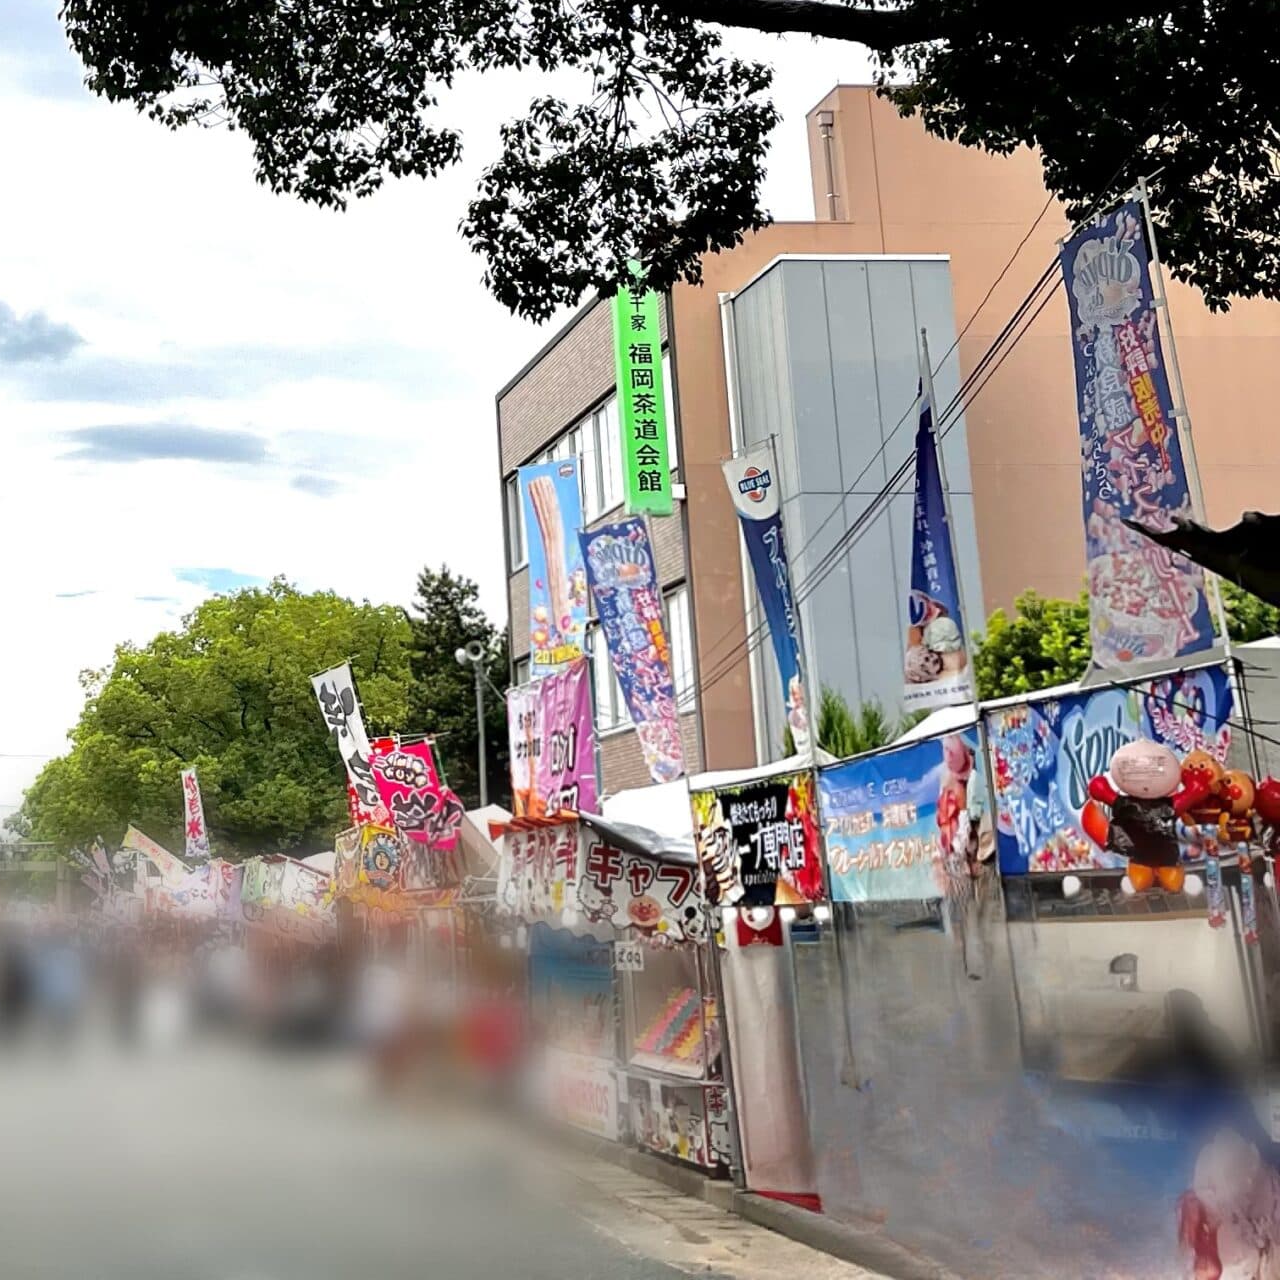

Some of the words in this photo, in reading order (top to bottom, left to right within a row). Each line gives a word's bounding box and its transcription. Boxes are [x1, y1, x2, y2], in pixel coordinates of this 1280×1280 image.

[628, 343, 662, 492] 福岡茶道会館
[740, 479, 756, 492] BLUE
[755, 474, 769, 487] SEAL
